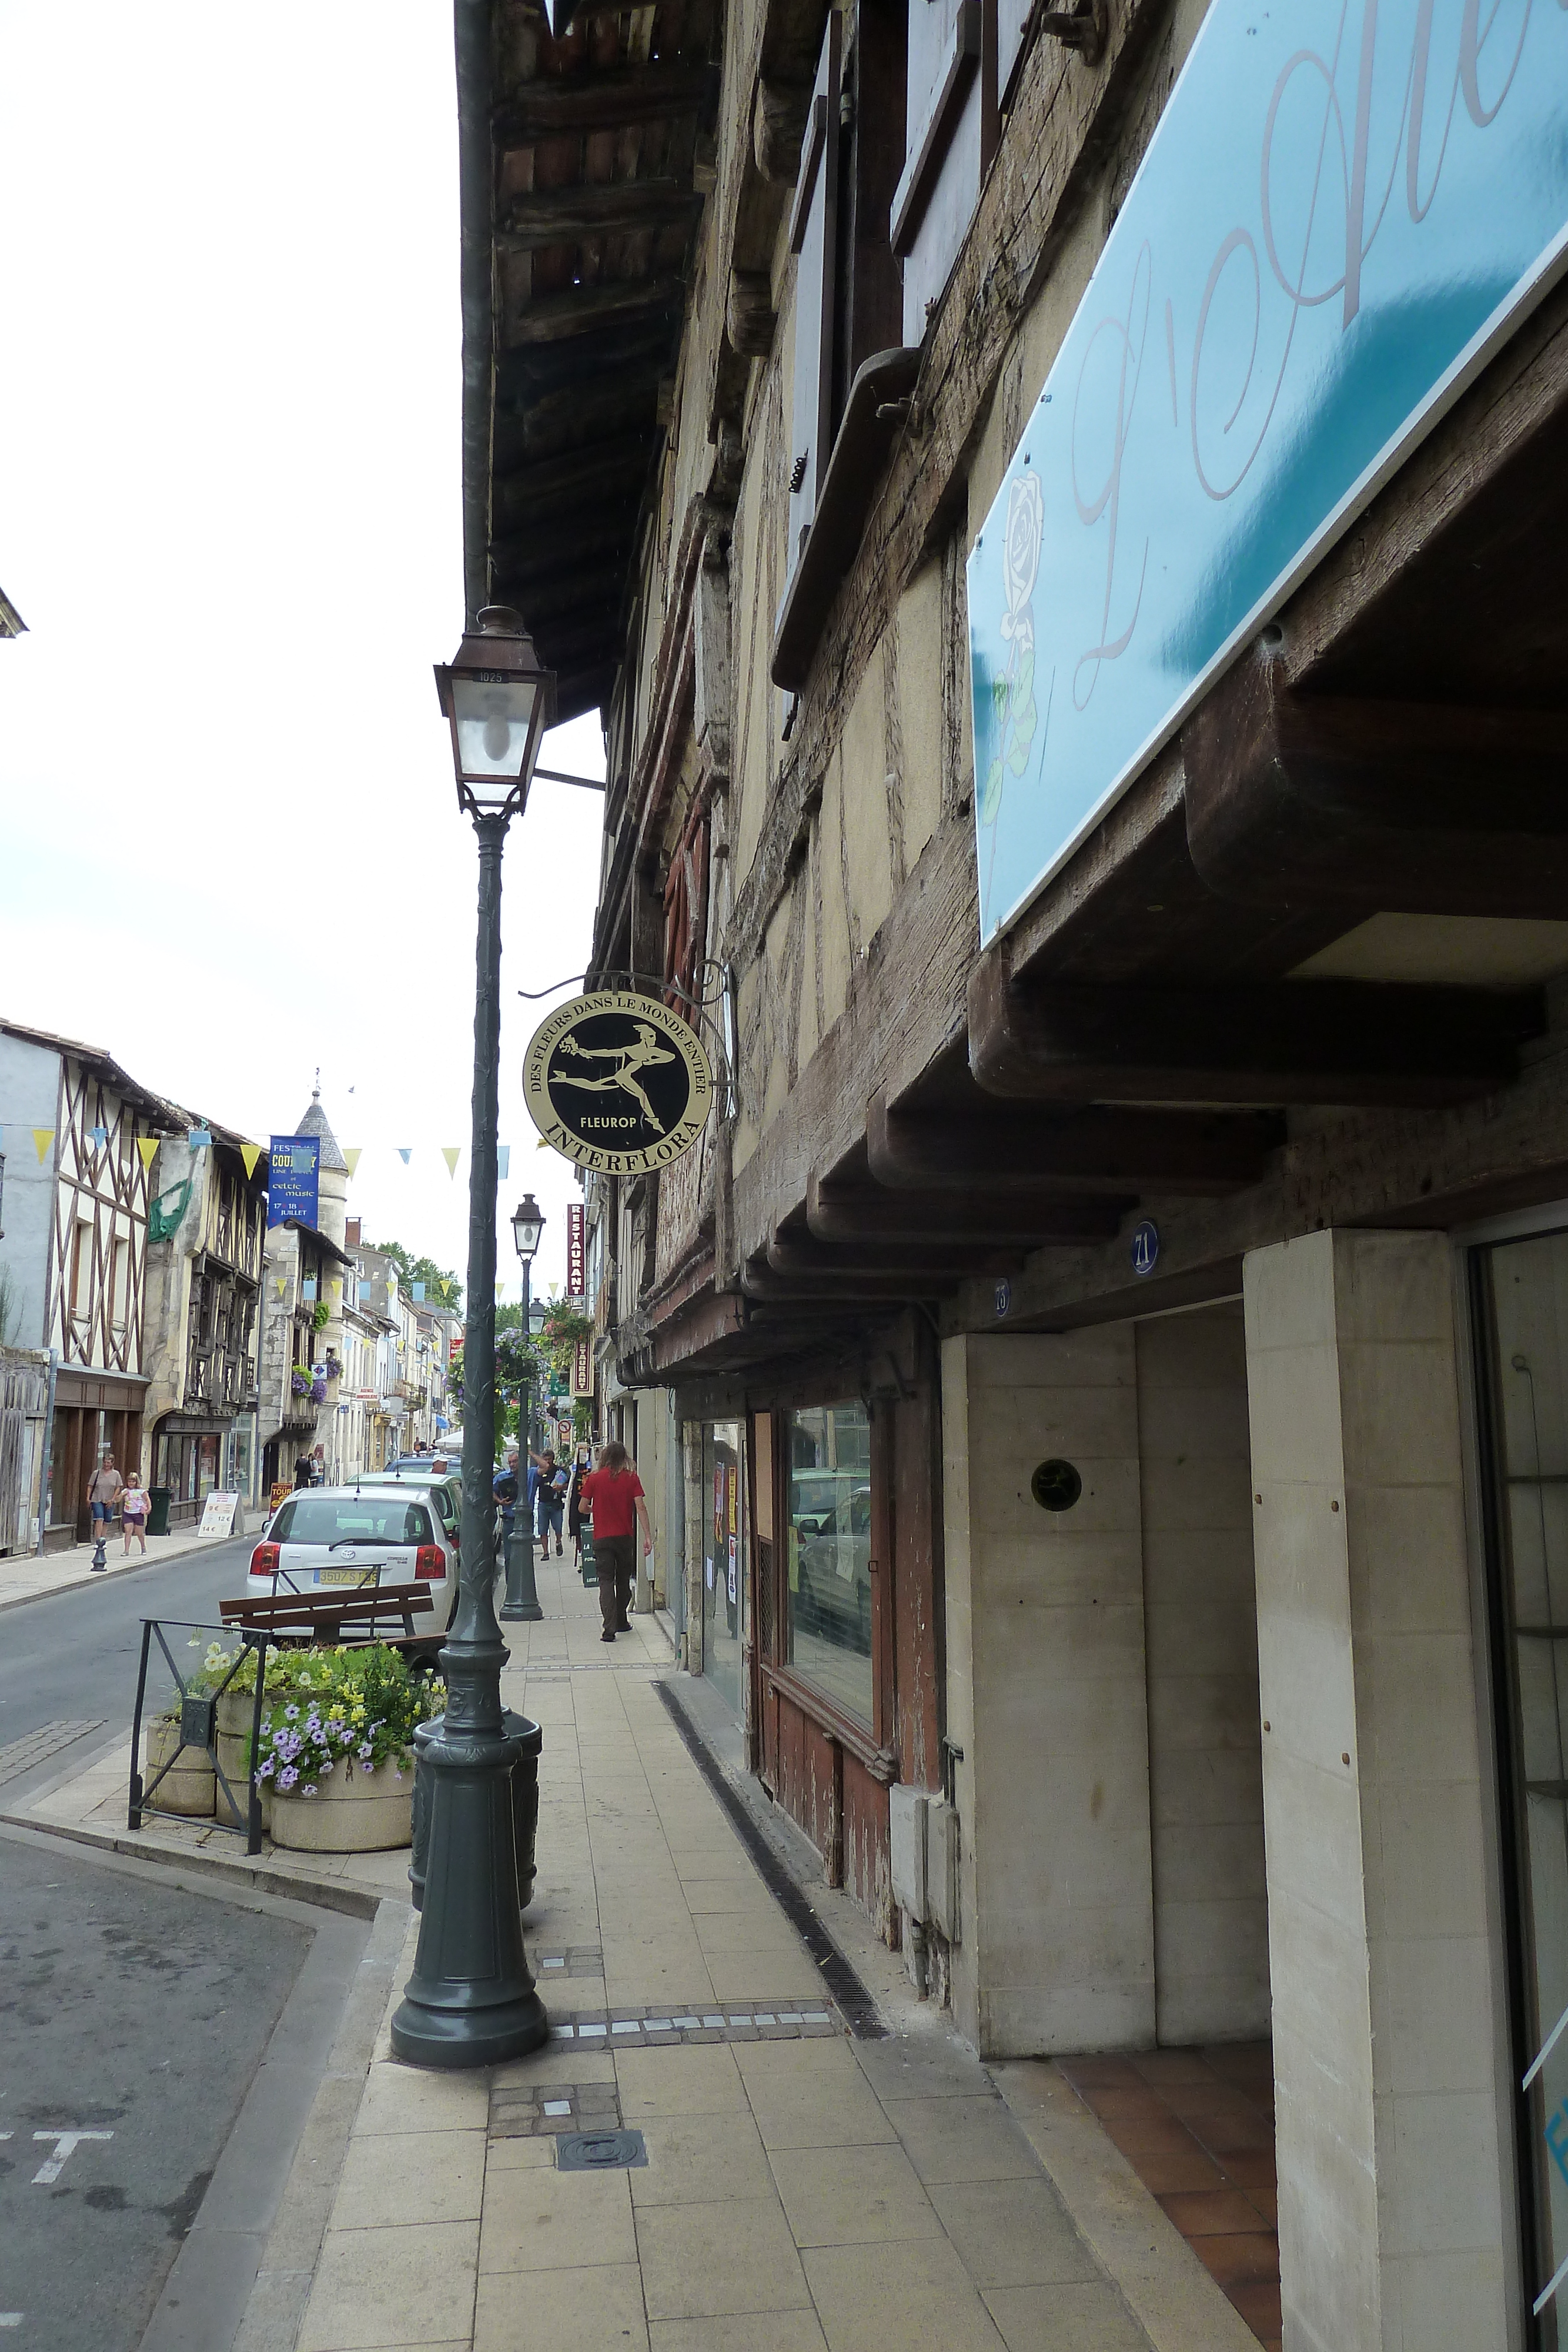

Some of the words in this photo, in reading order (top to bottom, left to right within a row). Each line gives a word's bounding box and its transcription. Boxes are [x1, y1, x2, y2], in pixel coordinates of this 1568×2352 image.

[480, 671, 502, 683] 1025
[573, 997, 613, 1015] DANS
[617, 997, 636, 1009] LE
[534, 1010, 573, 1060] FLEURS
[638, 1001, 687, 1040] MONDE
[531, 1064, 542, 1093] DES
[684, 1039, 706, 1095] ENTIER
[580, 1117, 637, 1128] FLEUROP
[544, 1120, 701, 1171] INTERFLORA
[272, 1154, 317, 1168] COUY
[571, 1205, 581, 1295] RESTAURANT
[1135, 1232, 1149, 1267] 71
[320, 1572, 347, 1581] 3507
